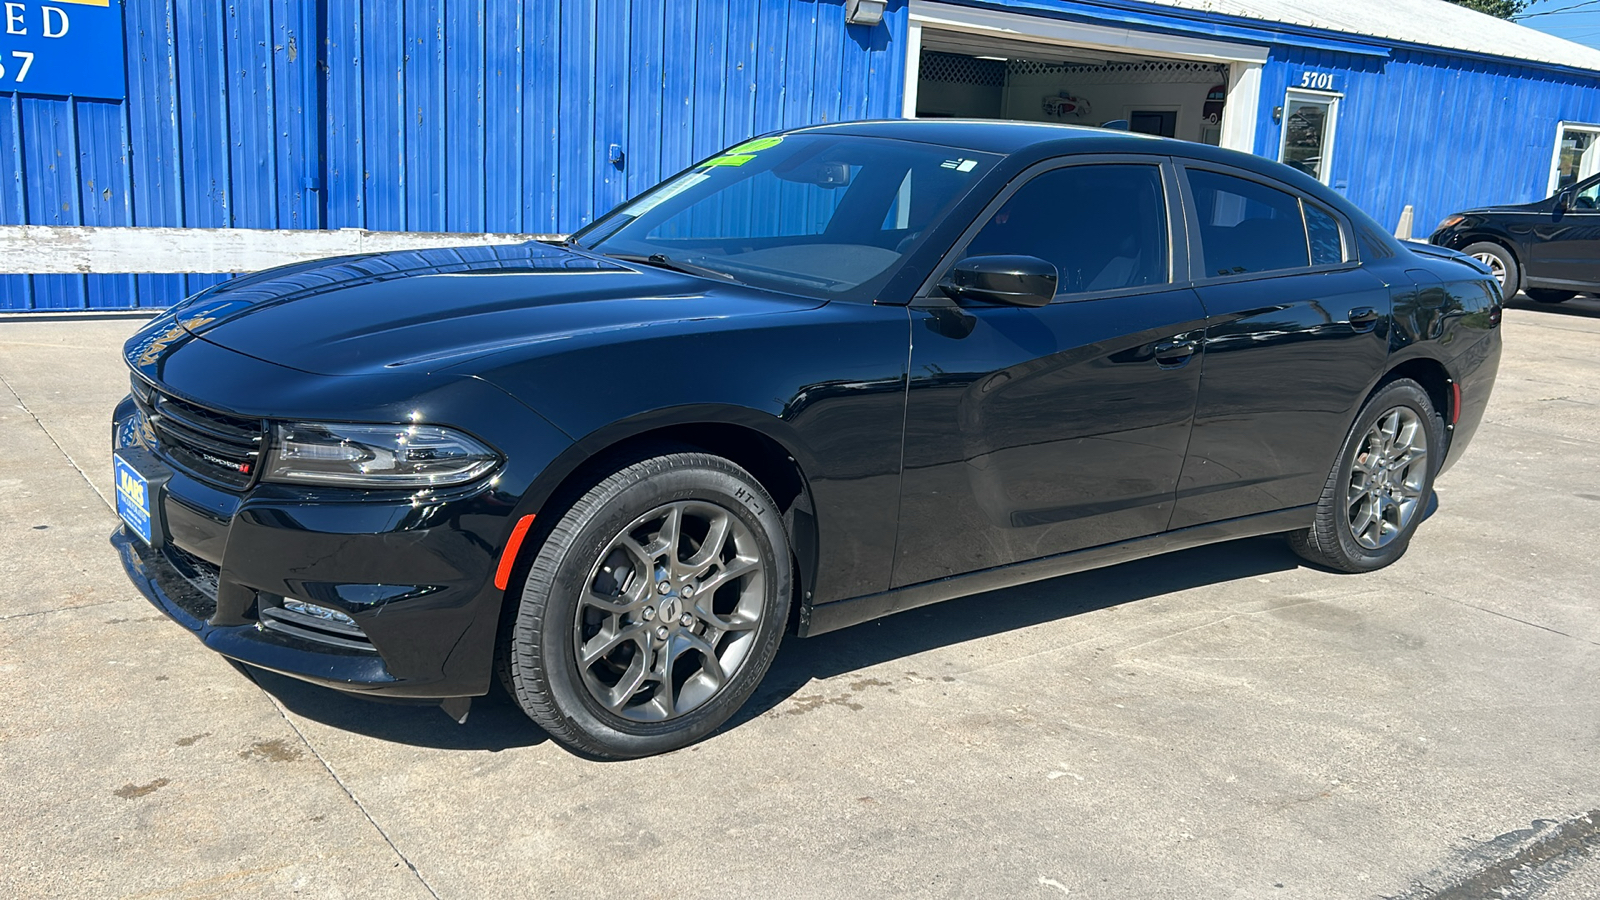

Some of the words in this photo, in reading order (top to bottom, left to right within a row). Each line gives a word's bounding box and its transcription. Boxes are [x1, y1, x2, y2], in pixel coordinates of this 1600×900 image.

[1300, 71, 1333, 90] 5701
[120, 469, 144, 507] KARS
[735, 487, 766, 516] HT-1
